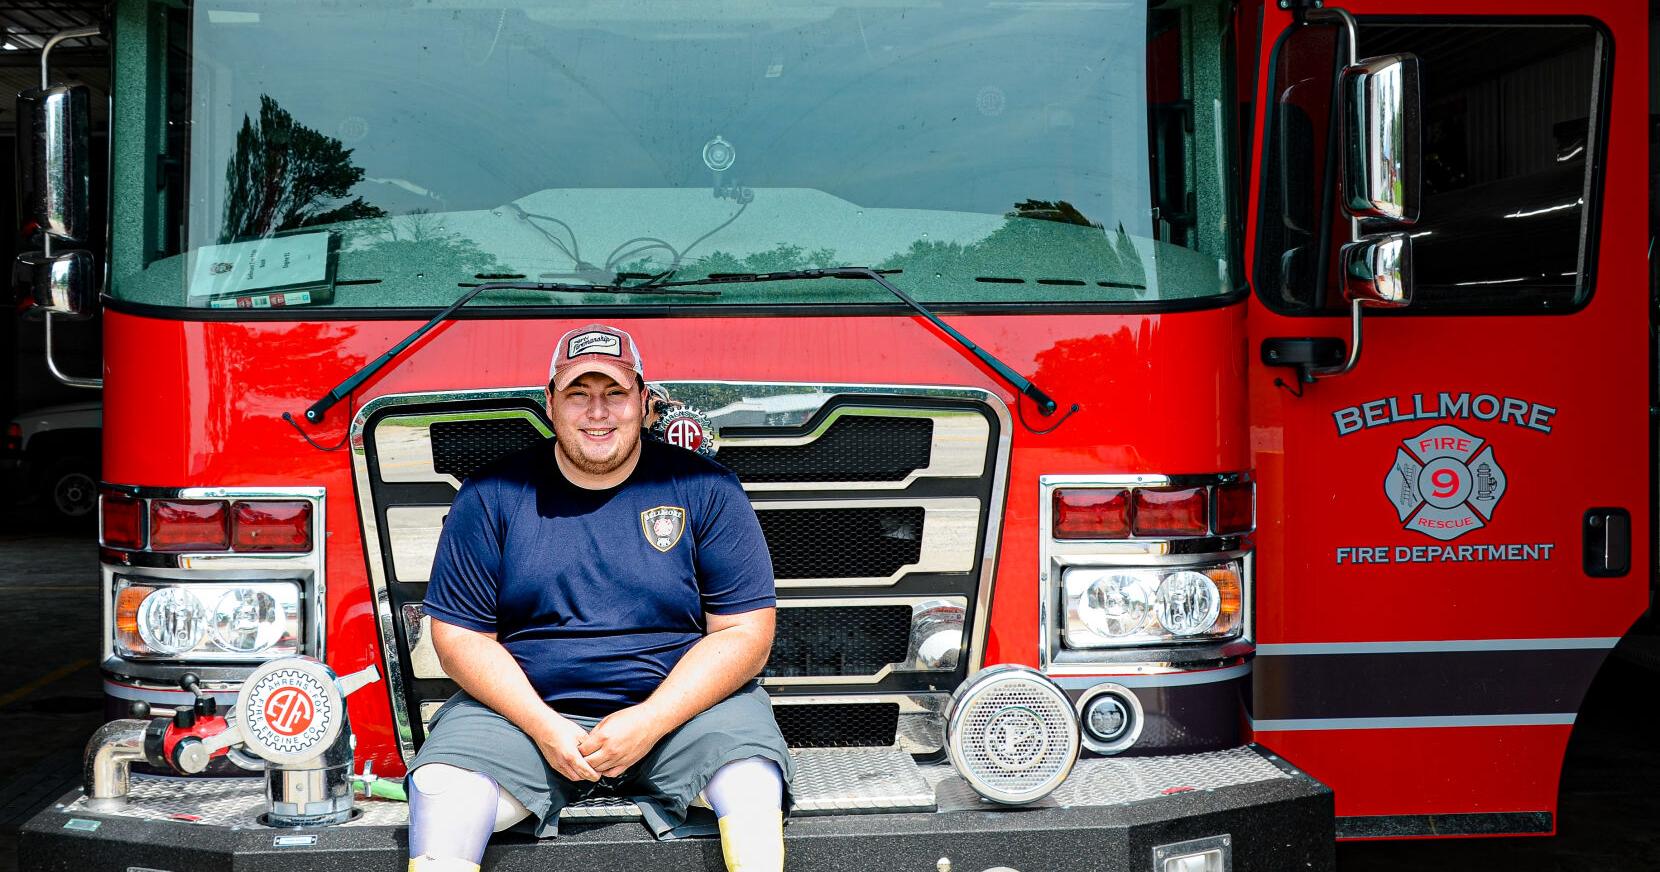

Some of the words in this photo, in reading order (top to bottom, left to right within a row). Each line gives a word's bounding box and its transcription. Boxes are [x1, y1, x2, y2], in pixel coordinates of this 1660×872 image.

[1333, 392, 1557, 437] BELLMORE
[1419, 437, 1472, 453] FIRE
[1431, 468, 1460, 498] 9
[1418, 516, 1473, 529] RESCUE
[1336, 546, 1390, 564] FIRE
[1394, 543, 1555, 563] DEPARTMENT
[261, 725, 300, 744] ENGINE
